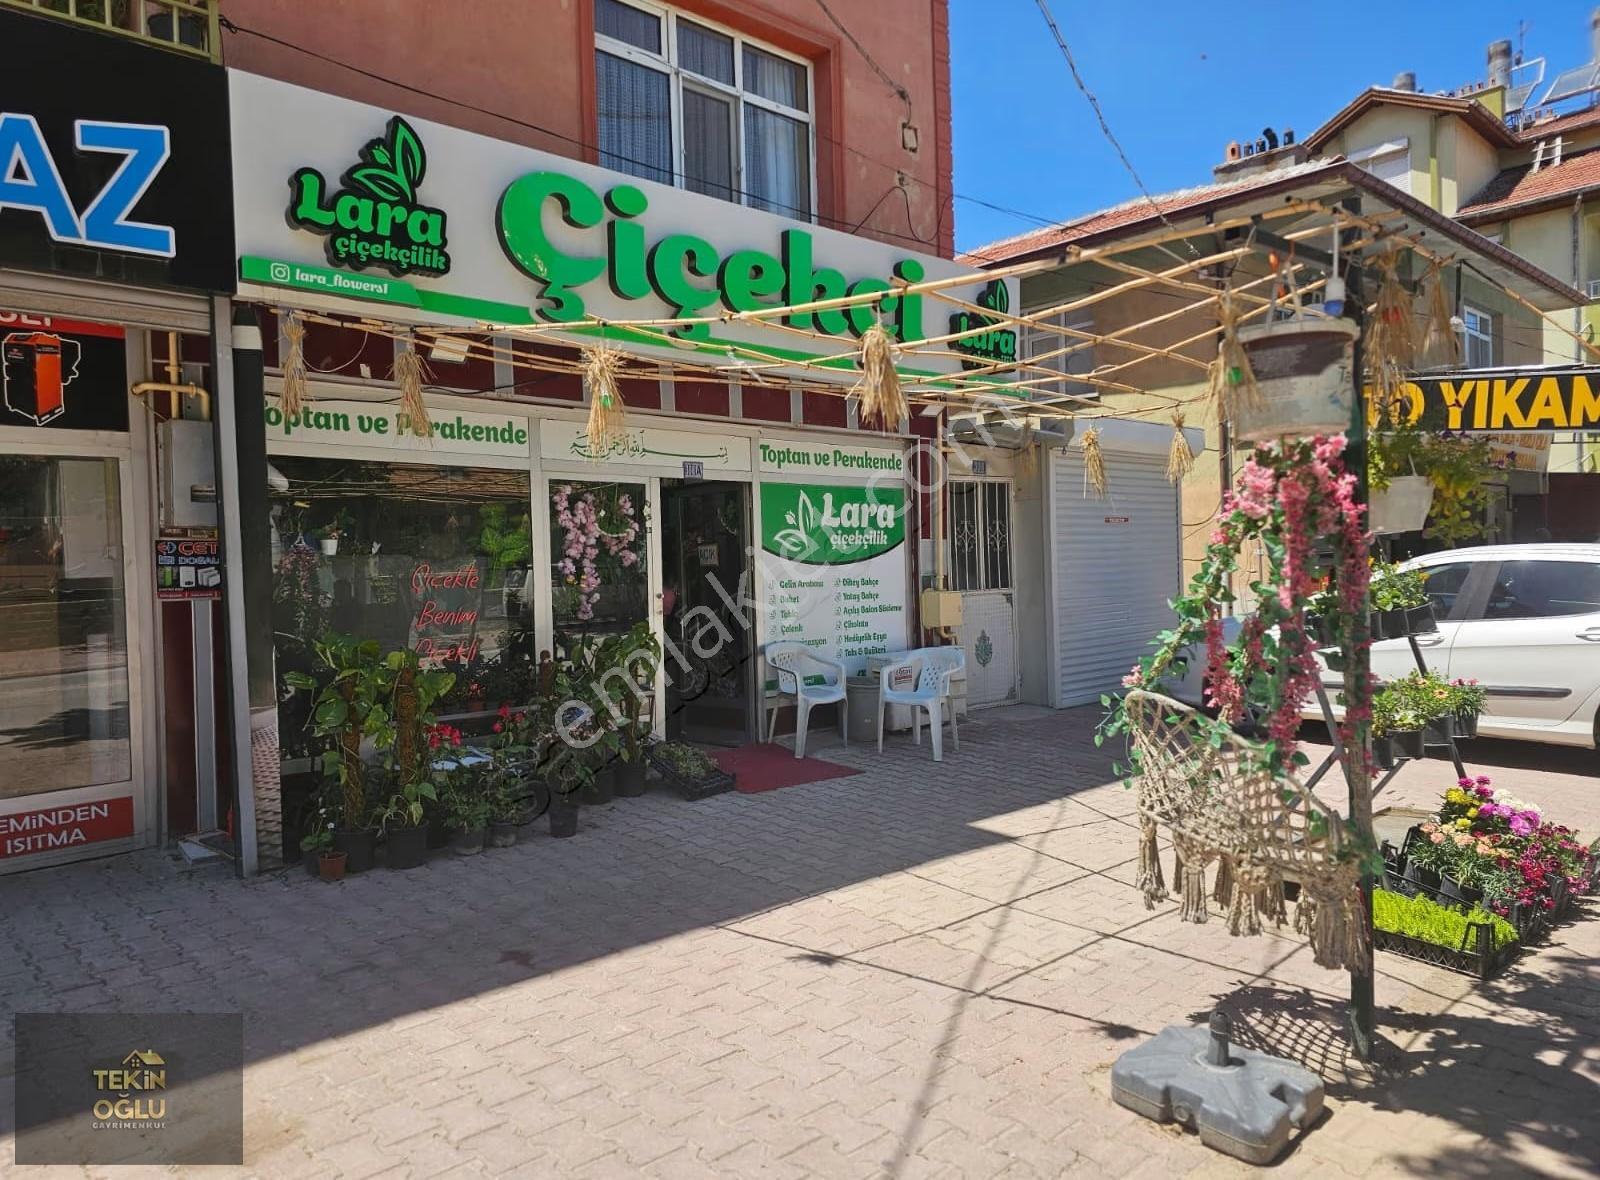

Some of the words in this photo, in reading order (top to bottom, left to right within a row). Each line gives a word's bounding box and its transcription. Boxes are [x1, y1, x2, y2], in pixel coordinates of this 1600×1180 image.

[297, 173, 443, 247] Lara
[334, 233, 447, 269] çiçekçilik
[263, 400, 351, 435] optan
[357, 415, 389, 434] ve
[396, 413, 528, 445] Prakende
[760, 444, 811, 468] Toptan
[814, 452, 830, 466] ve
[833, 449, 902, 471] Perakende
[821, 492, 896, 529] Lara
[830, 529, 888, 550] çiçekçilik
[779, 579, 797, 589] Gelin
[860, 577, 879, 587] Bahçe
[861, 591, 879, 602] Bahçe
[6, 827, 88, 855] ISITMA
